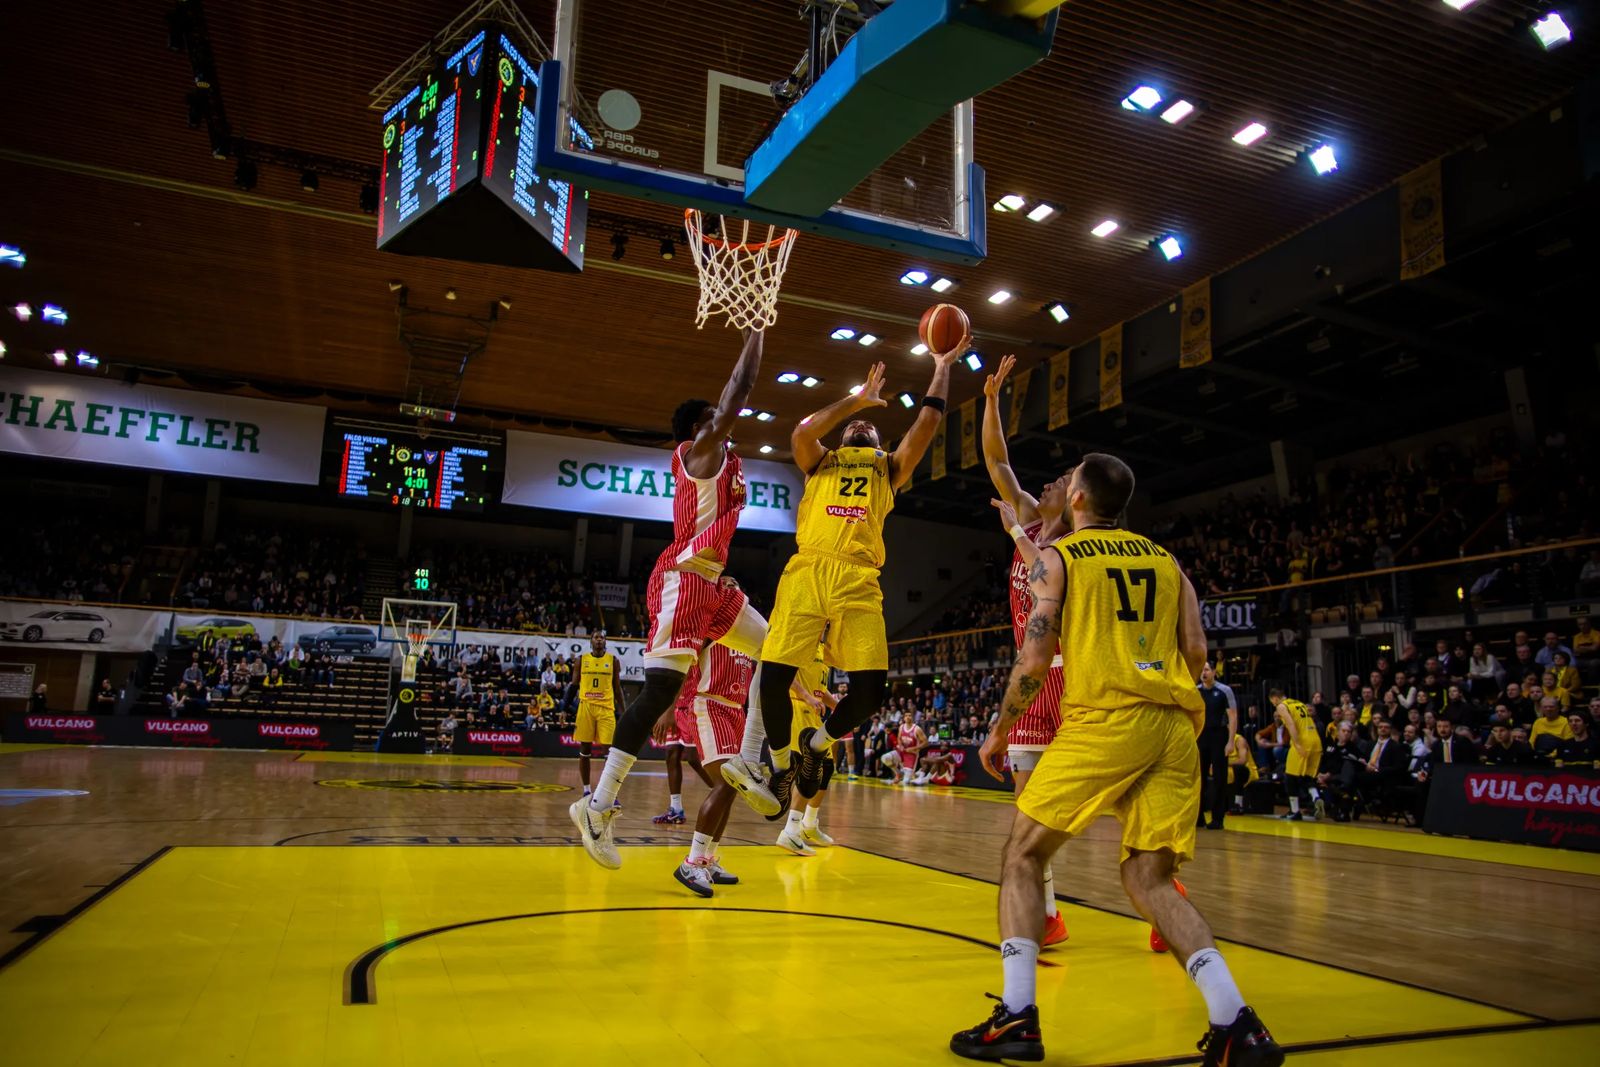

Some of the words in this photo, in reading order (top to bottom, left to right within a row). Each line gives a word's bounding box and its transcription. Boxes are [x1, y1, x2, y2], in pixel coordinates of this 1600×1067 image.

[500, 34, 518, 61] FALCO
[421, 81, 439, 103] 4:01
[519, 86, 525, 102] 3
[419, 95, 437, 120] 11-11
[400, 121, 406, 135] 3
[344, 433, 362, 442] FALCO
[362, 435, 388, 445] VULCANO
[452, 446, 468, 455] UCAM
[467, 448, 489, 458] MURCIA
[403, 466, 427, 479] 11-11
[404, 477, 430, 491] 4:01
[840, 476, 868, 497] 22
[392, 495, 400, 506] 3
[414, 577, 430, 590] 10
[1105, 567, 1157, 622] 17
[593, 678, 599, 688] 0
[28, 717, 95, 729] VULCANO
[147, 721, 209, 732] VULCANO
[260, 725, 319, 736] VULCANO
[391, 730, 419, 738] APTIV
[470, 732, 522, 743] VULCANO
